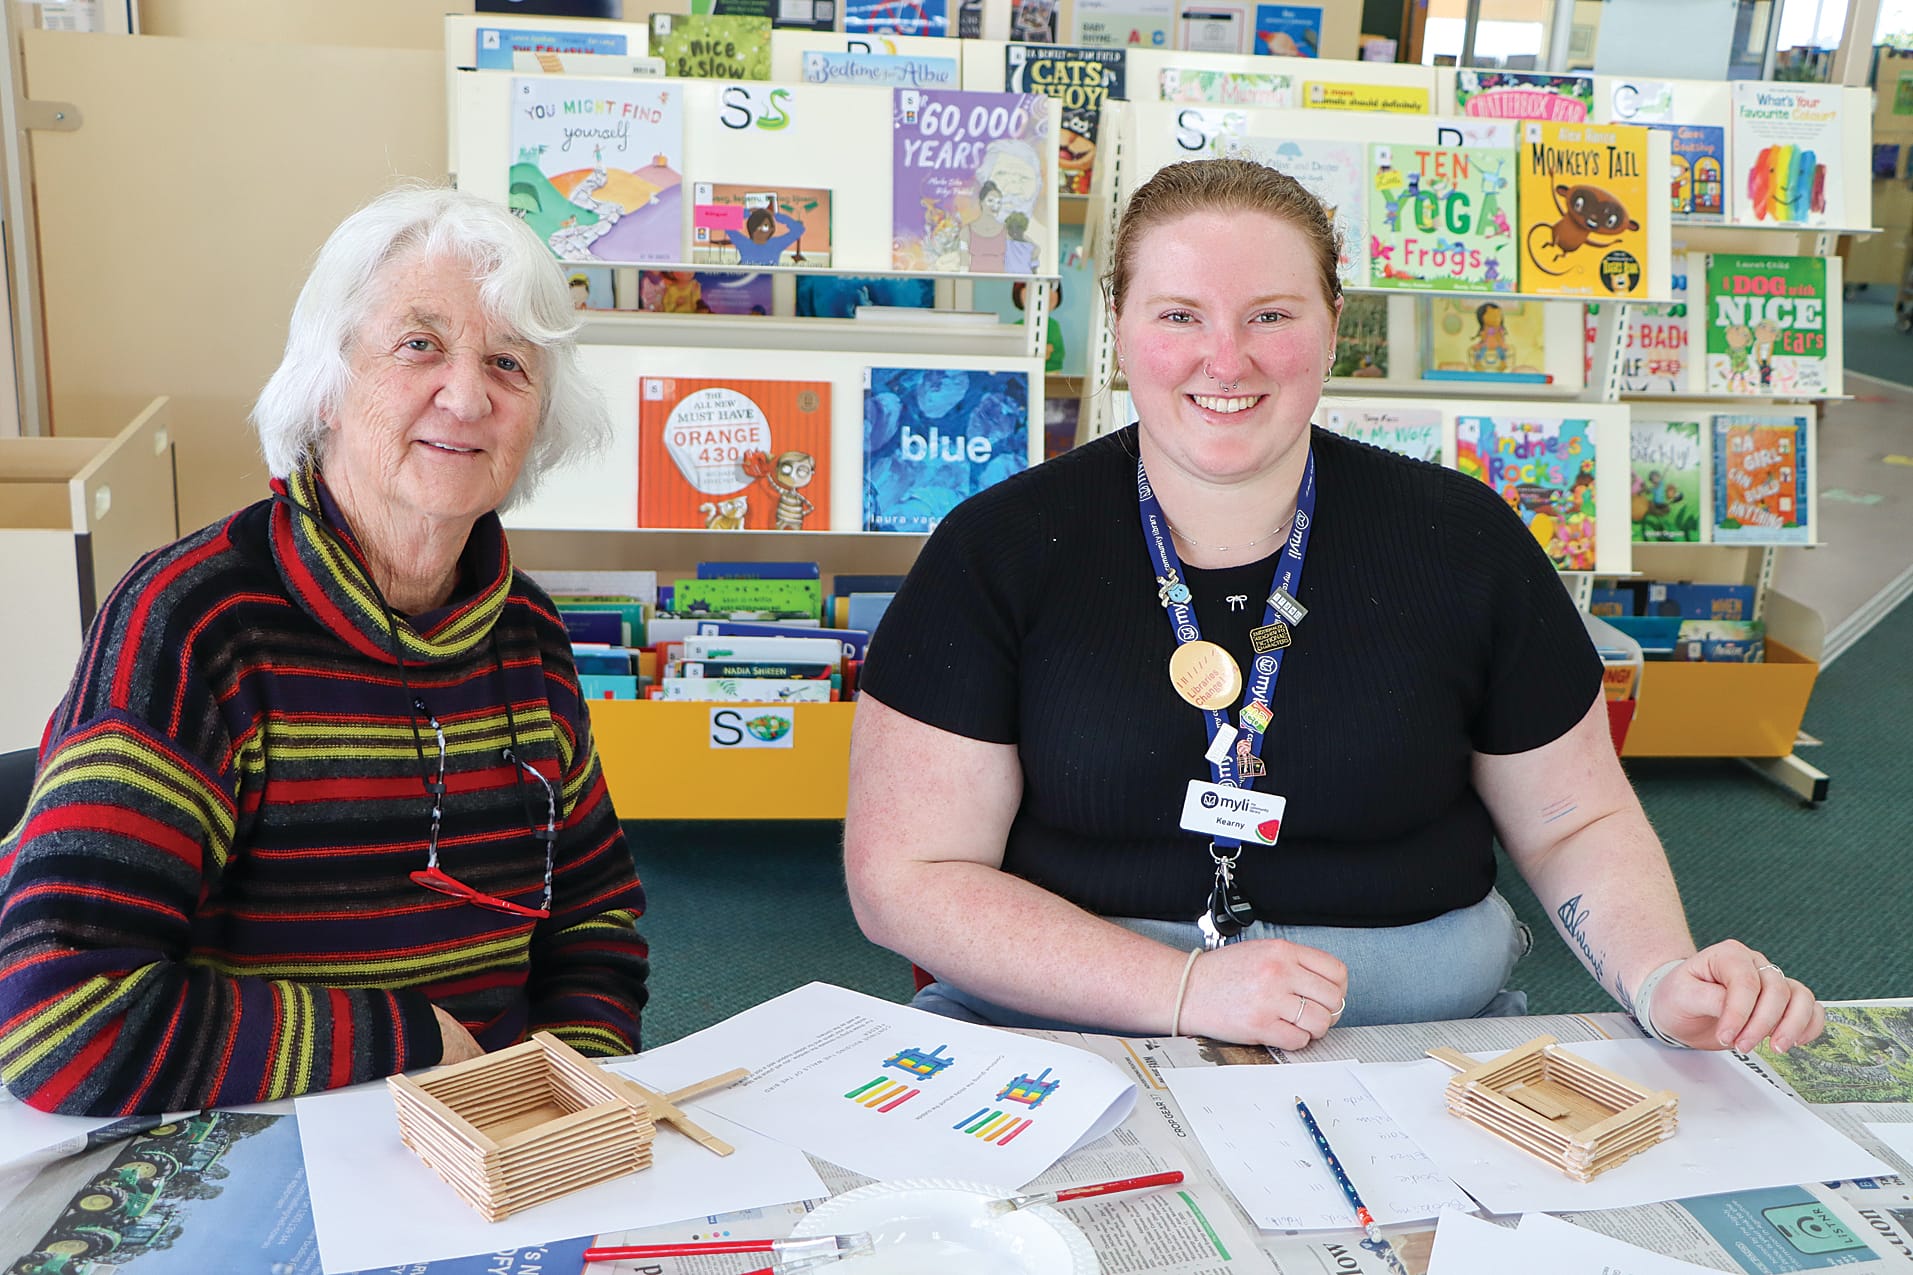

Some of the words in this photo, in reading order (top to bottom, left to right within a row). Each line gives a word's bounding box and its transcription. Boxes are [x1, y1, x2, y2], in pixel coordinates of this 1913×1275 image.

[691, 34, 736, 60] nice
[678, 59, 694, 79] &
[696, 57, 745, 80] slow
[1031, 60, 1103, 86] CATS
[525, 103, 556, 121] YOU
[564, 99, 616, 115] MIGHT
[622, 102, 662, 124] FIND
[720, 87, 751, 130] S
[1740, 106, 1789, 120] Favourite
[1756, 93, 1794, 108] What's
[920, 103, 1030, 141] 60,000
[1177, 110, 1207, 151] S
[562, 121, 631, 152] yourself
[903, 139, 983, 170] YEARS
[1414, 150, 1469, 180] TEN
[1532, 142, 1600, 177] MONKEY'S
[1606, 145, 1641, 179] TAIL
[1380, 188, 1502, 236] YOGA
[1404, 238, 1482, 275] Frogs
[1732, 275, 1786, 297] DOG
[1715, 295, 1824, 330] NICE
[694, 402, 712, 410] ALL
[714, 399, 737, 408] NEW
[705, 391, 722, 400] THE
[677, 411, 714, 423] MUST
[718, 408, 754, 421] HAVE
[673, 427, 761, 447] ORANGE
[902, 425, 993, 464] blue
[1743, 448, 1784, 471] GIRL
[724, 666, 751, 676] NADIA
[753, 666, 788, 677] SHIREEN
[1187, 669, 1219, 698] Libraries
[713, 710, 744, 746] S
[1220, 797, 1250, 813] myli
[1216, 816, 1246, 830] Kearny
[1156, 1101, 1175, 1119] GEAR
[1168, 1119, 1187, 1138] CROP
